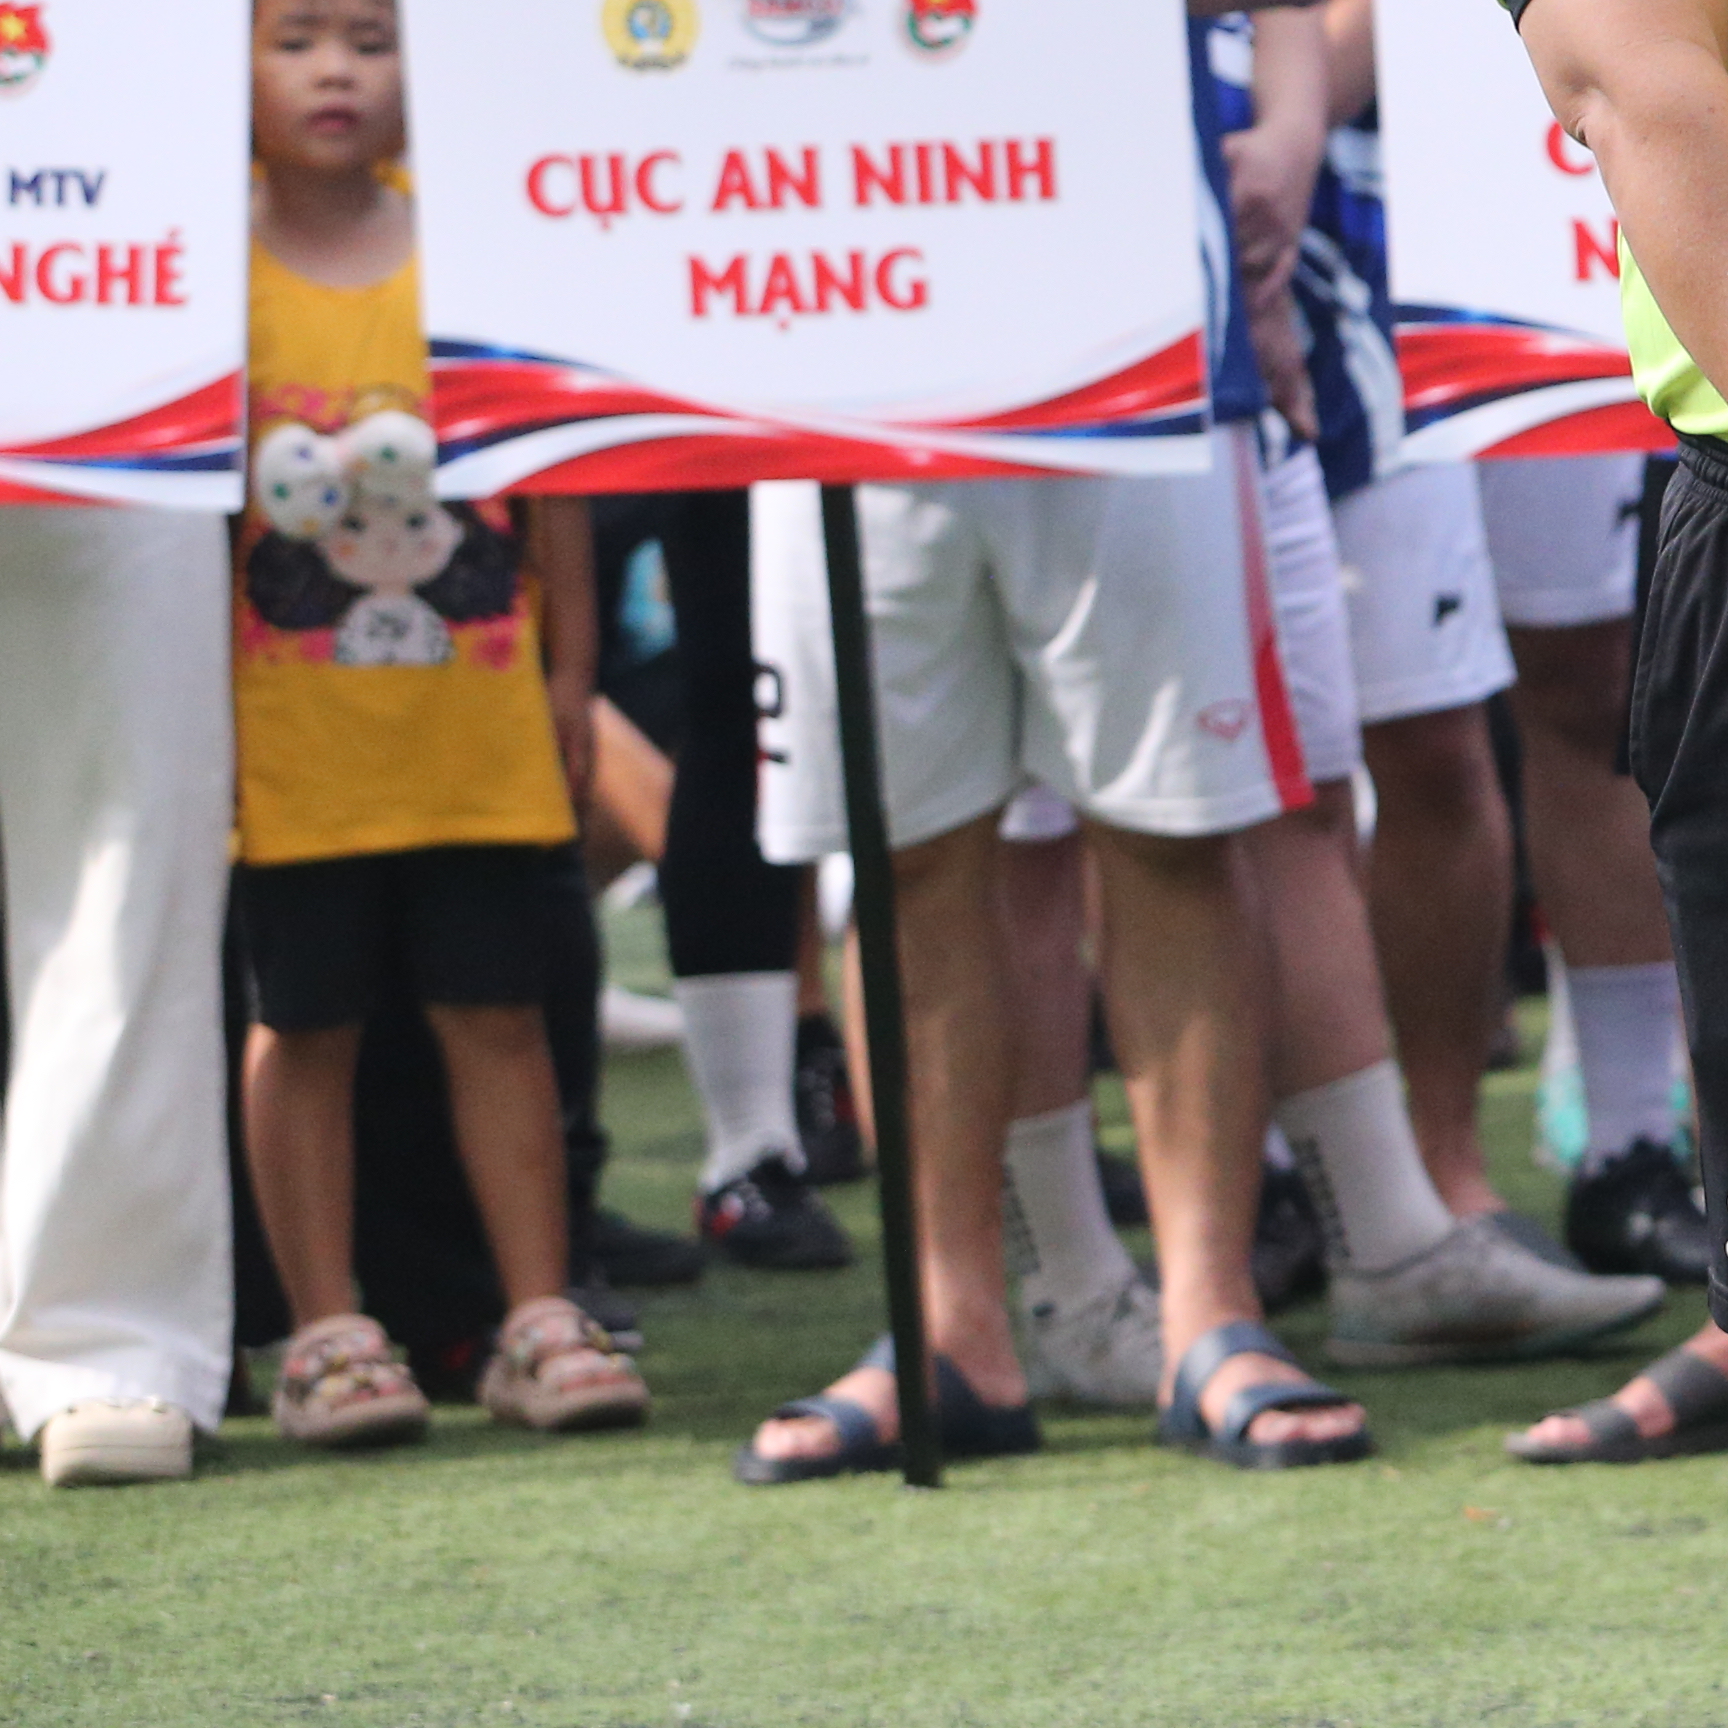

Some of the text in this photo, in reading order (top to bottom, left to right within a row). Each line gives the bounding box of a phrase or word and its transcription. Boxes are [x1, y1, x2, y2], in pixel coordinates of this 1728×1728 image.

[9, 168, 106, 208] MTV
[525, 137, 1058, 232] CỤC AN NINH
[687, 246, 930, 332] MẠNG
